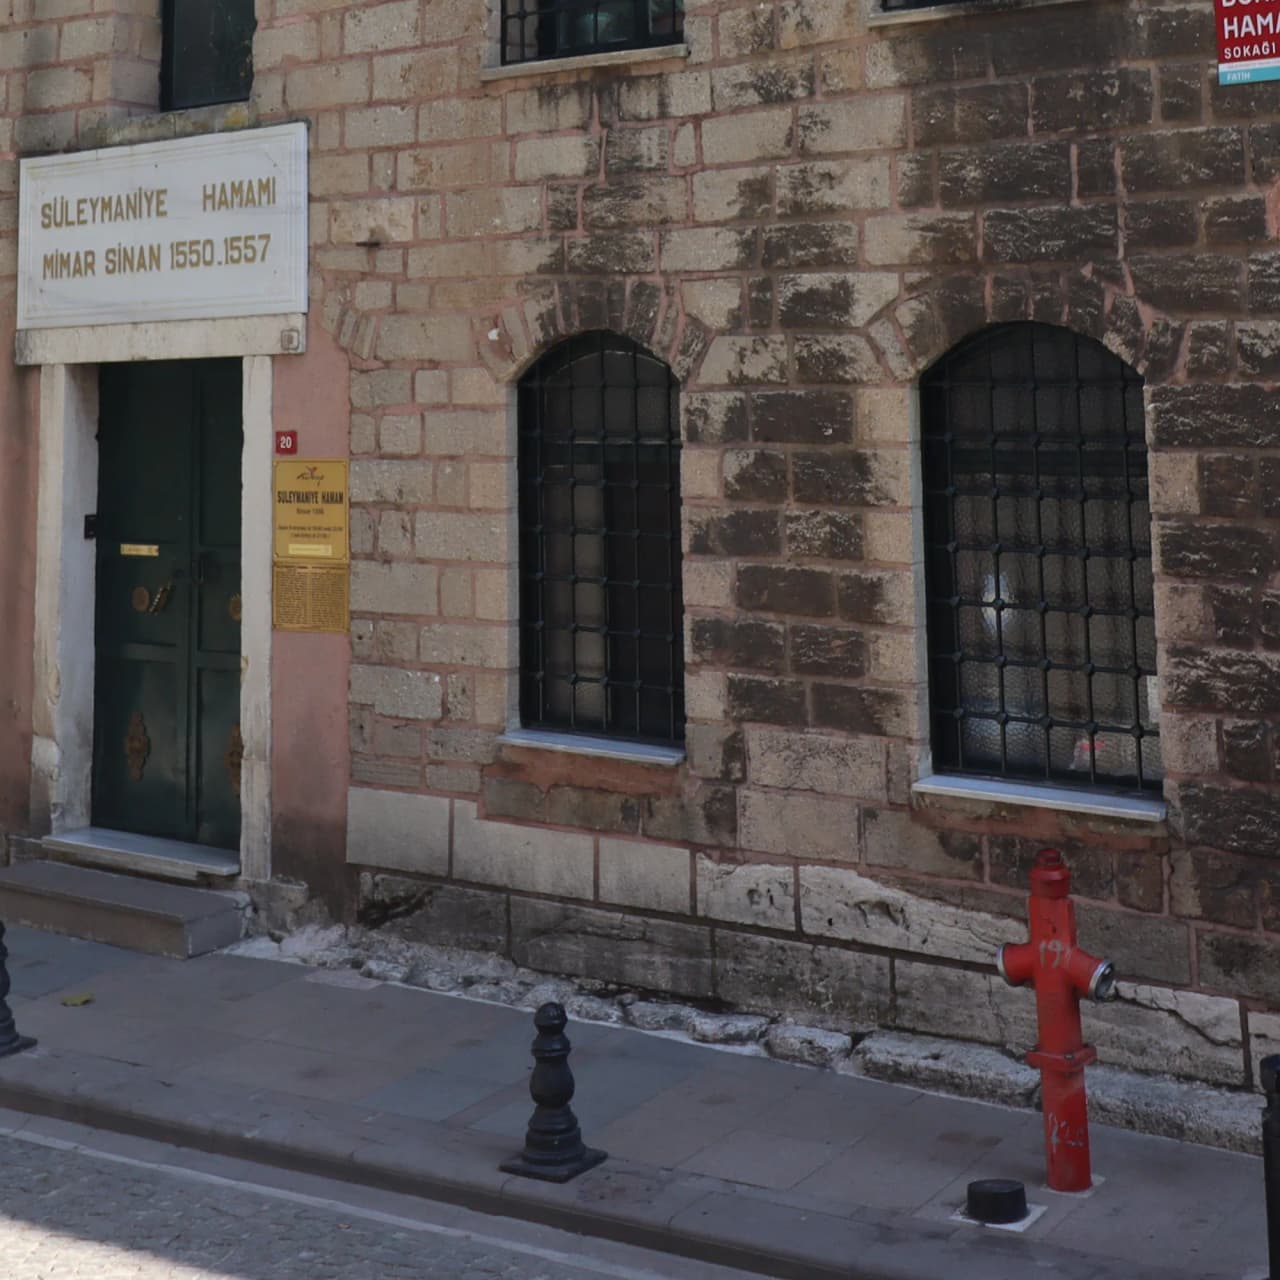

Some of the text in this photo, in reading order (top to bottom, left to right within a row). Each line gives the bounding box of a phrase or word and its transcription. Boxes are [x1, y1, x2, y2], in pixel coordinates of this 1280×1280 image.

[1223, 40, 1277, 60] SOKAĞI
[40, 175, 277, 230] SÜLEYMANİYE HAMAMI
[42, 248, 96, 281] MİMAR
[104, 241, 162, 275] SİNAN
[280, 435, 293, 449] 20
